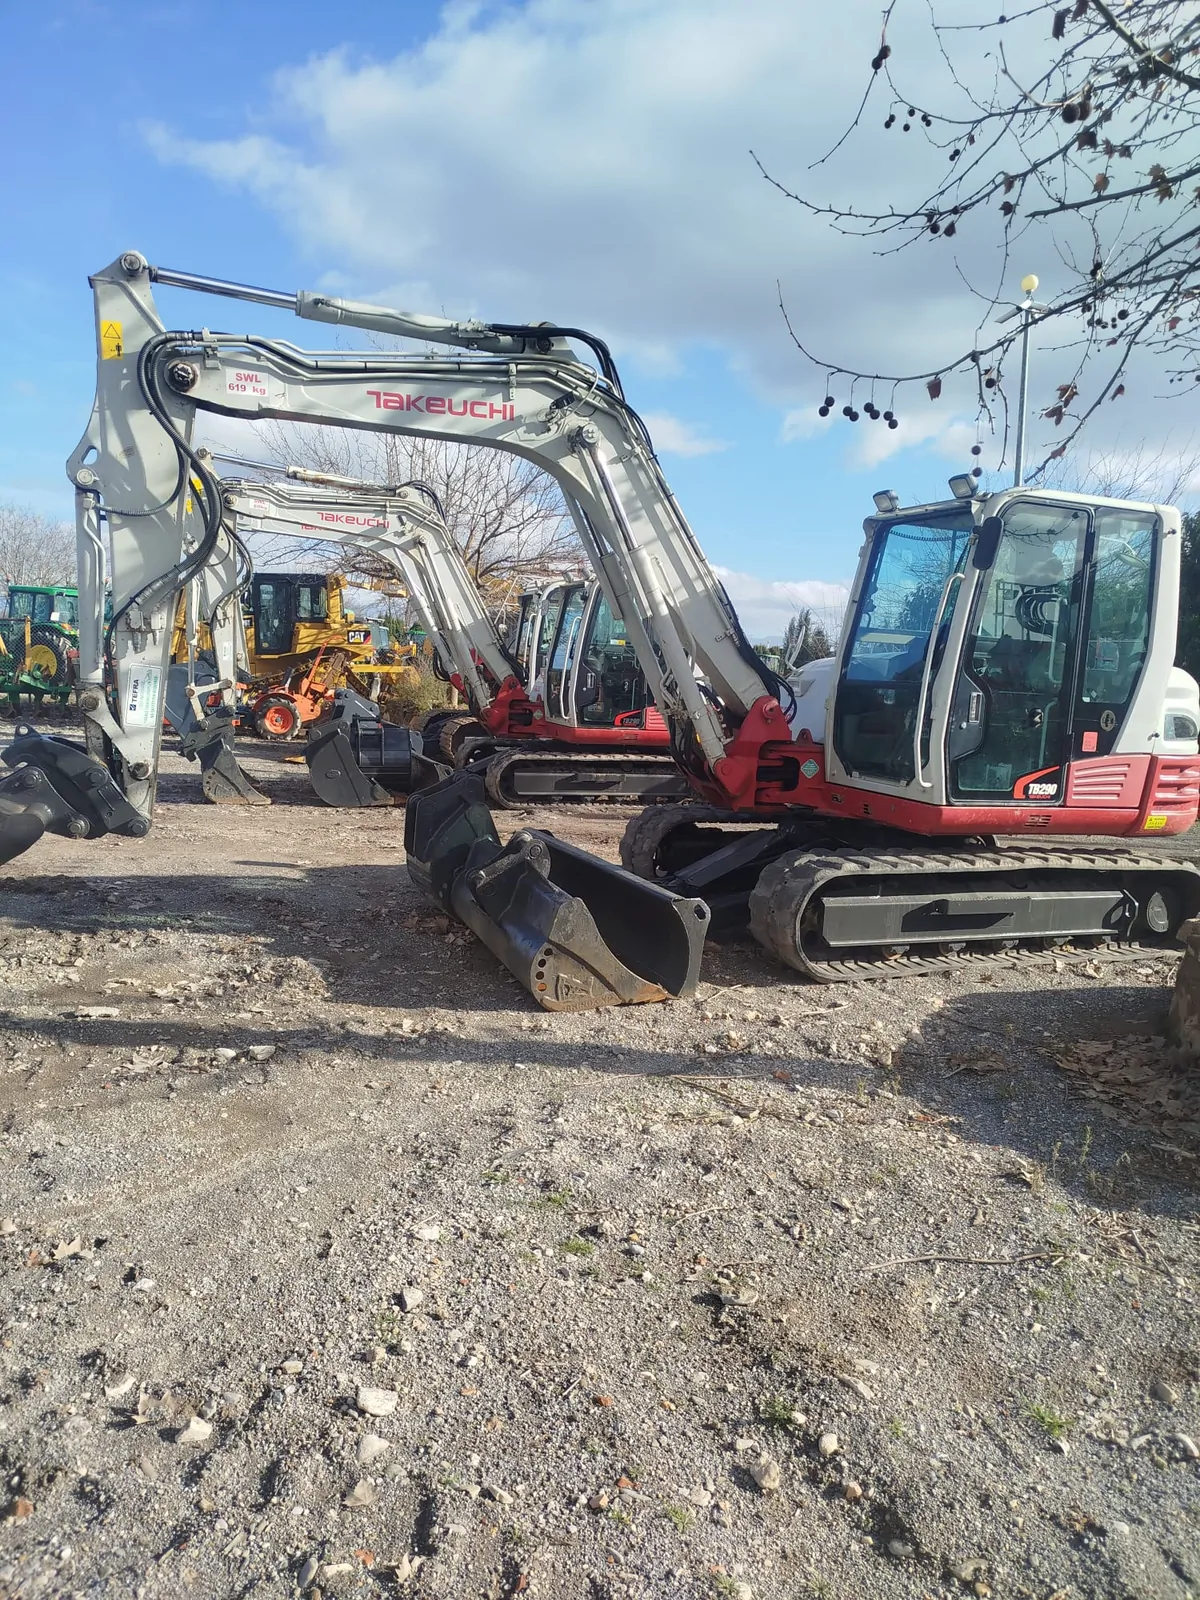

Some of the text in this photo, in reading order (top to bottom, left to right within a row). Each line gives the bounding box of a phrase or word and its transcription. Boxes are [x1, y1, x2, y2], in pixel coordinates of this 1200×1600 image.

[235, 372, 262, 383] SWL
[228, 382, 267, 396] 619 kg
[348, 631, 365, 643] CAT
[131, 679, 140, 703] TEFRA
[1028, 783, 1058, 796] TB290
